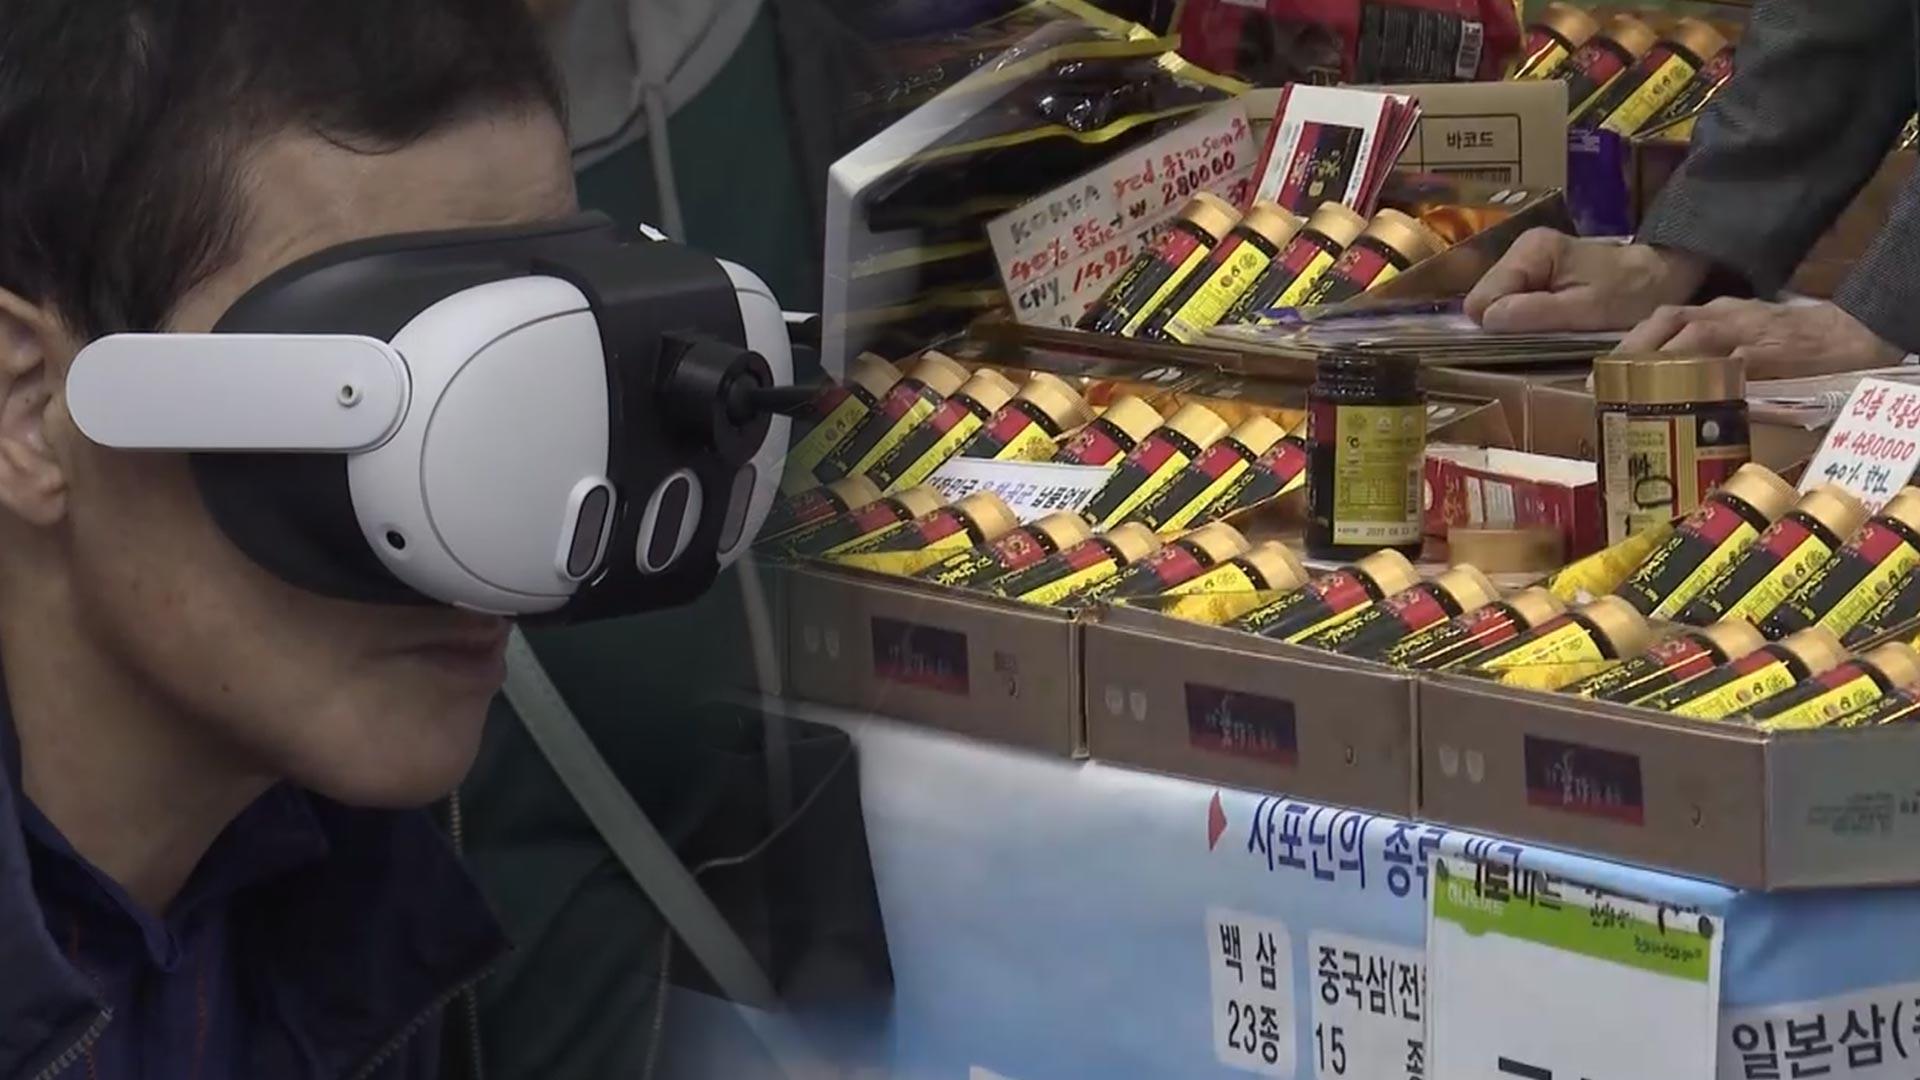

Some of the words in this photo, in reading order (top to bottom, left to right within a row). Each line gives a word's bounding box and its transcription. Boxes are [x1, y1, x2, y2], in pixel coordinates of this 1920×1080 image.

[1446, 130, 1494, 149] 바코드
[1010, 185, 1100, 245] KOREA
[1010, 237, 1068, 281] 40%
[1824, 462, 1863, 485] 40%
[1248, 795, 1374, 890] 사포닌의
[1318, 945, 1427, 1022] 중국삼(전
[1228, 999, 1281, 1066] 23종
[1316, 1021, 1347, 1077] 15
[1732, 998, 1920, 1080] 일본삼(
